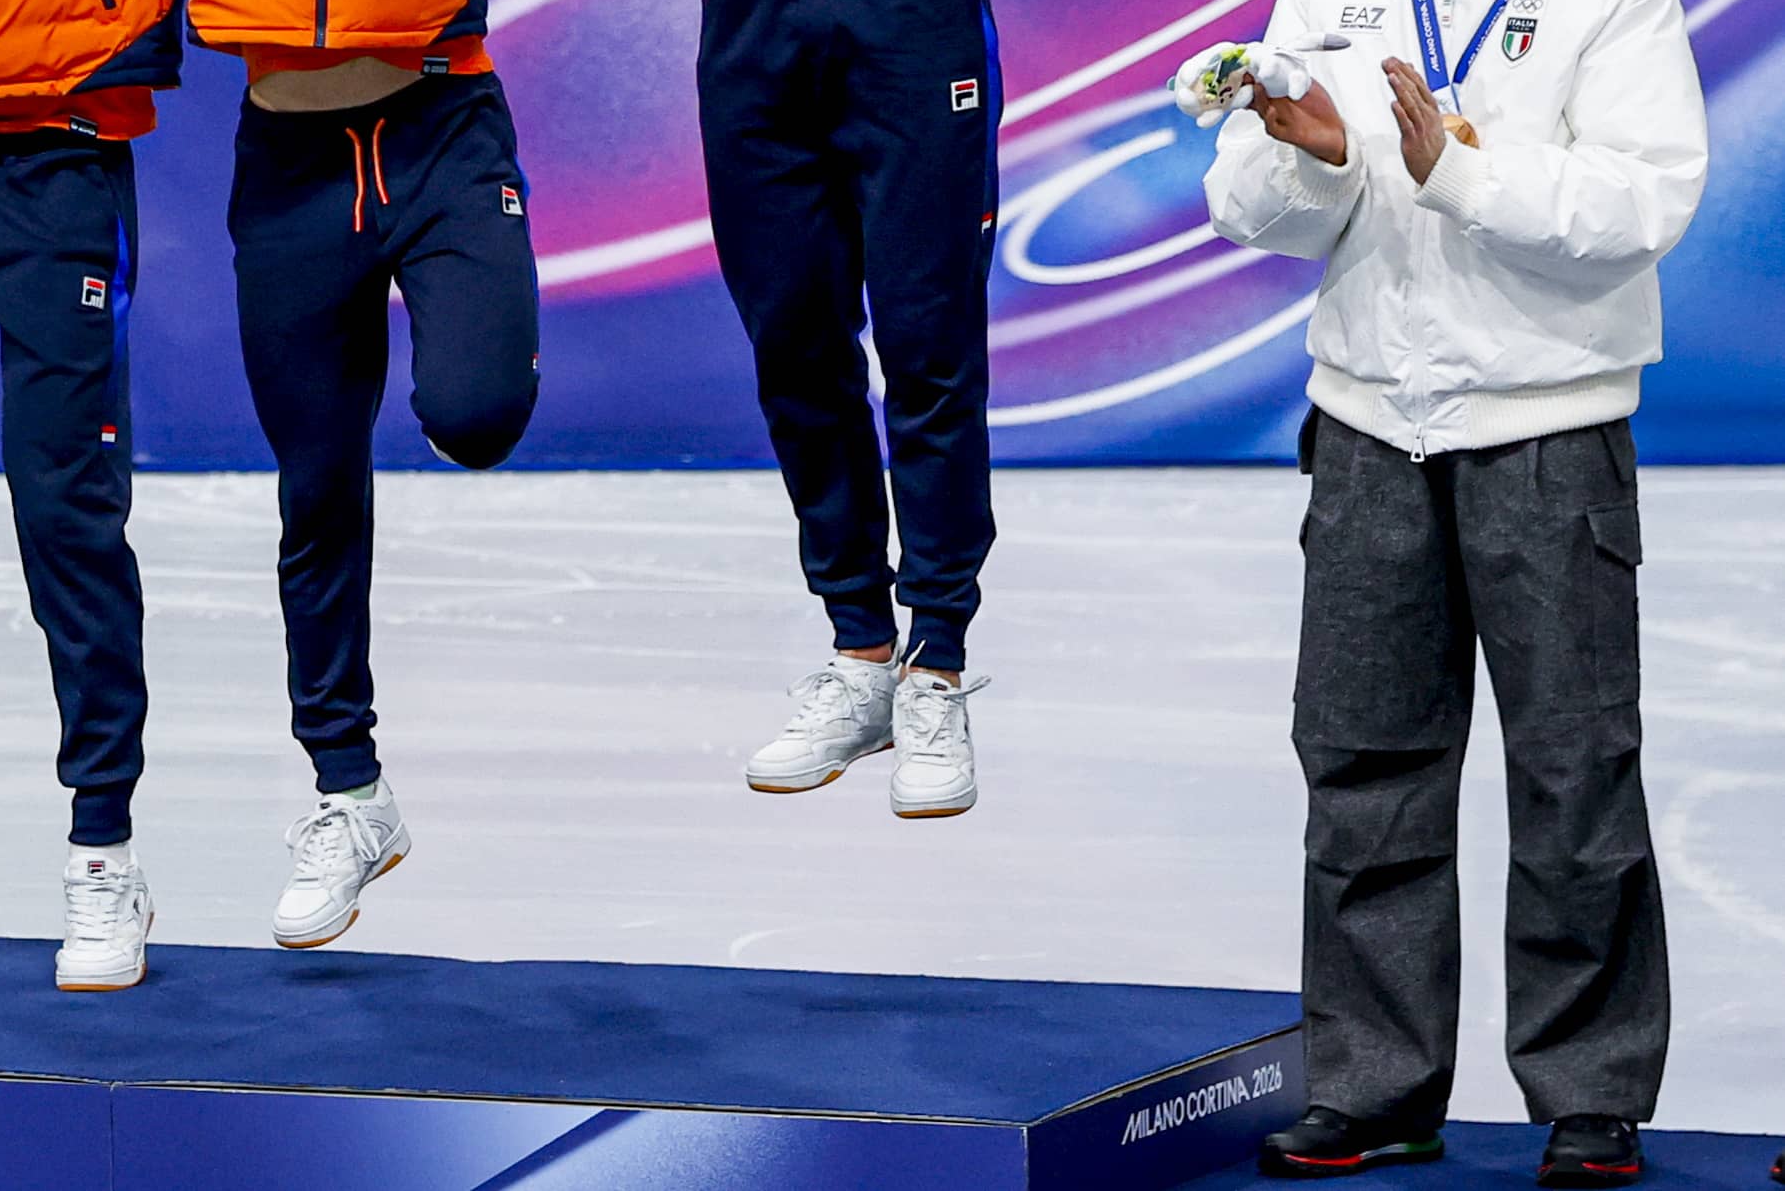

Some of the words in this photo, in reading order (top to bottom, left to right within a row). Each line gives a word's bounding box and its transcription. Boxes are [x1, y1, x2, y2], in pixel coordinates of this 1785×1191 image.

[1340, 6, 1387, 25] EA7
[1508, 19, 1535, 27] ITALIA
[1121, 1096, 1185, 1145] MILANO
[1187, 1075, 1250, 1121] CORTINA
[1252, 1061, 1283, 1099] 2026
